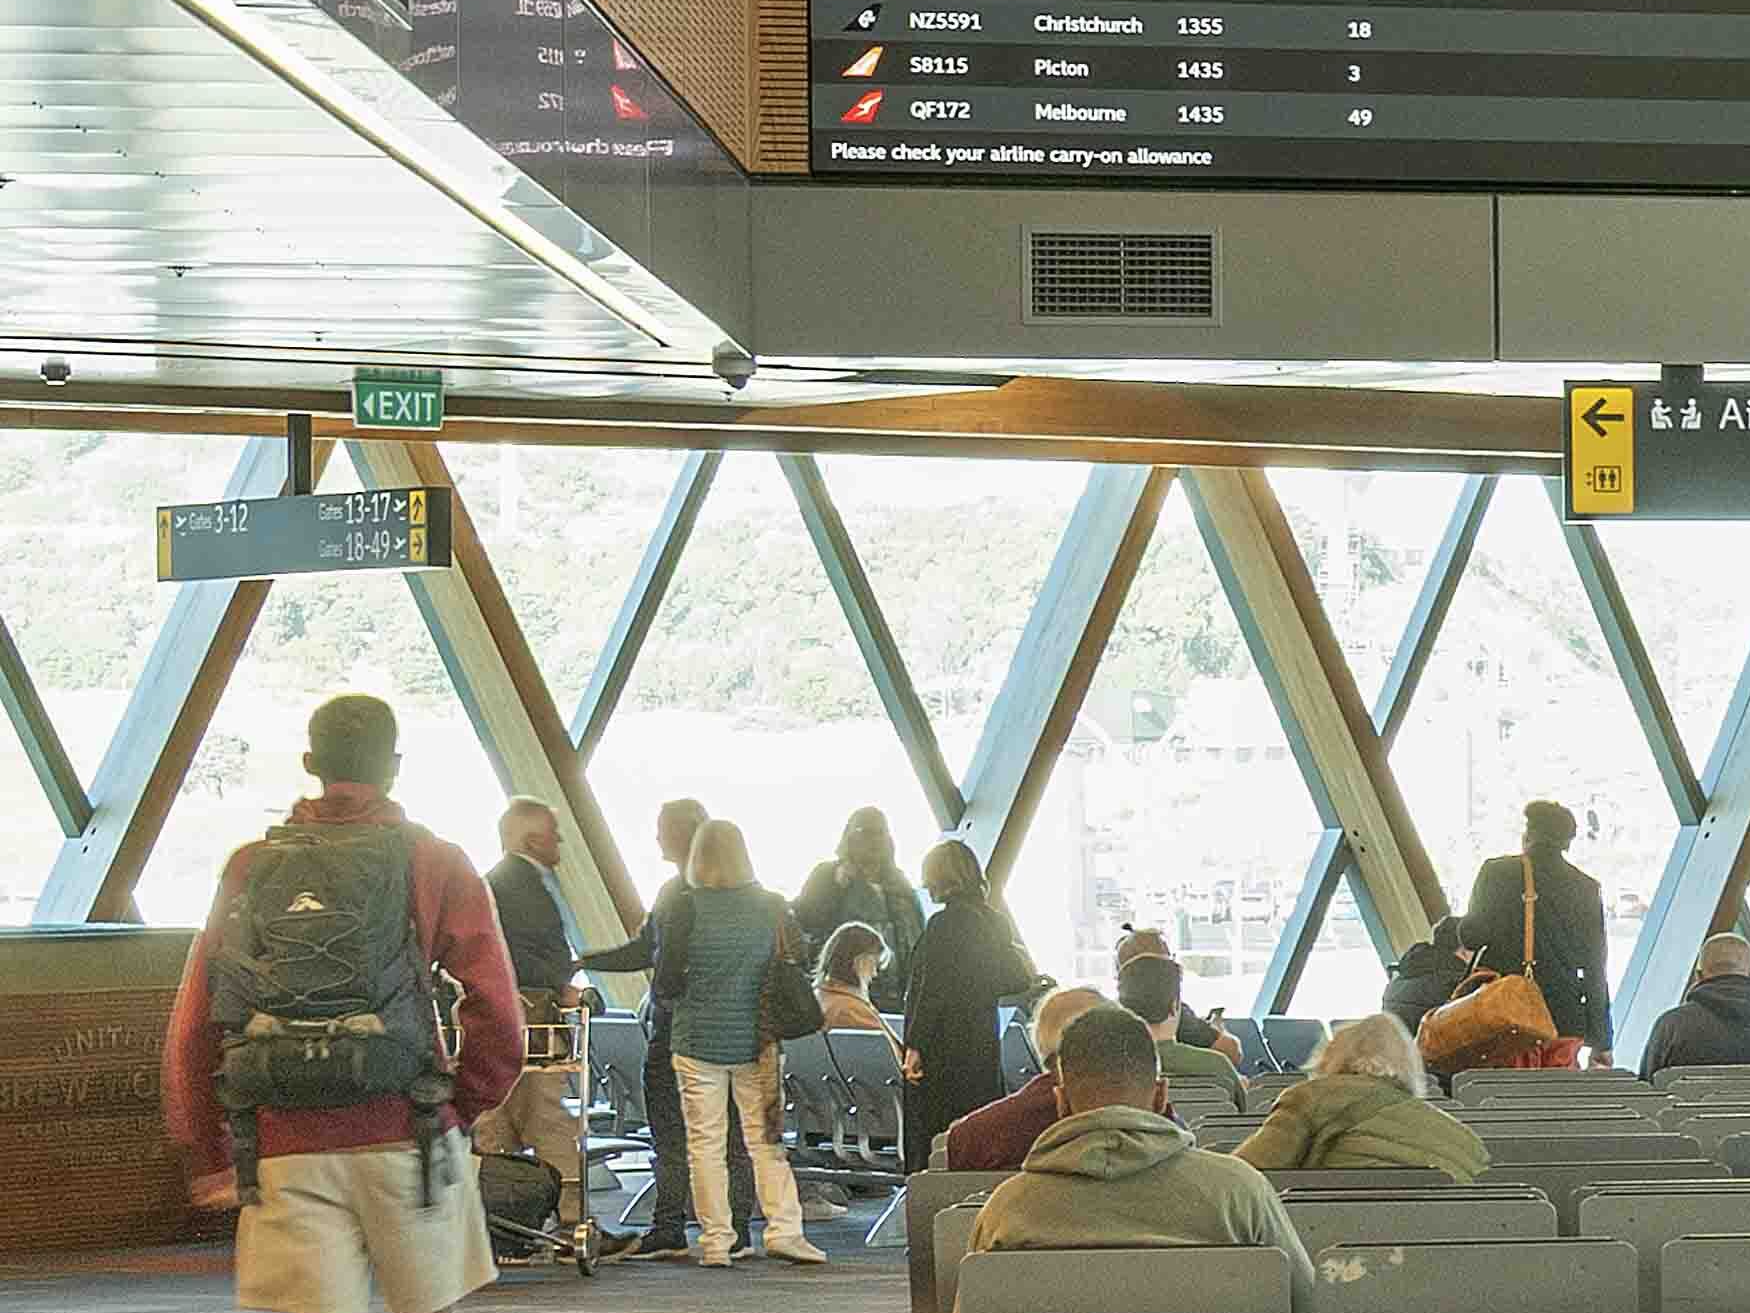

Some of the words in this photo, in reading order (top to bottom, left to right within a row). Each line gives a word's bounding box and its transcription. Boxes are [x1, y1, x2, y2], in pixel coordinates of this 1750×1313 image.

[910, 101, 971, 121] QF172
[1035, 103, 1127, 122] Melbourne
[1178, 105, 1224, 123] 1435
[1347, 109, 1373, 126] 49
[831, 142, 887, 160] Please
[891, 143, 940, 161] check
[945, 148, 986, 166] your
[990, 145, 1045, 163] airline
[1049, 149, 1123, 168] carry-on
[1126, 147, 1213, 165] allowance
[379, 392, 436, 421] EXIT
[214, 504, 248, 534] 3-12
[345, 492, 390, 525] 13-17
[346, 530, 390, 561] 18-49
